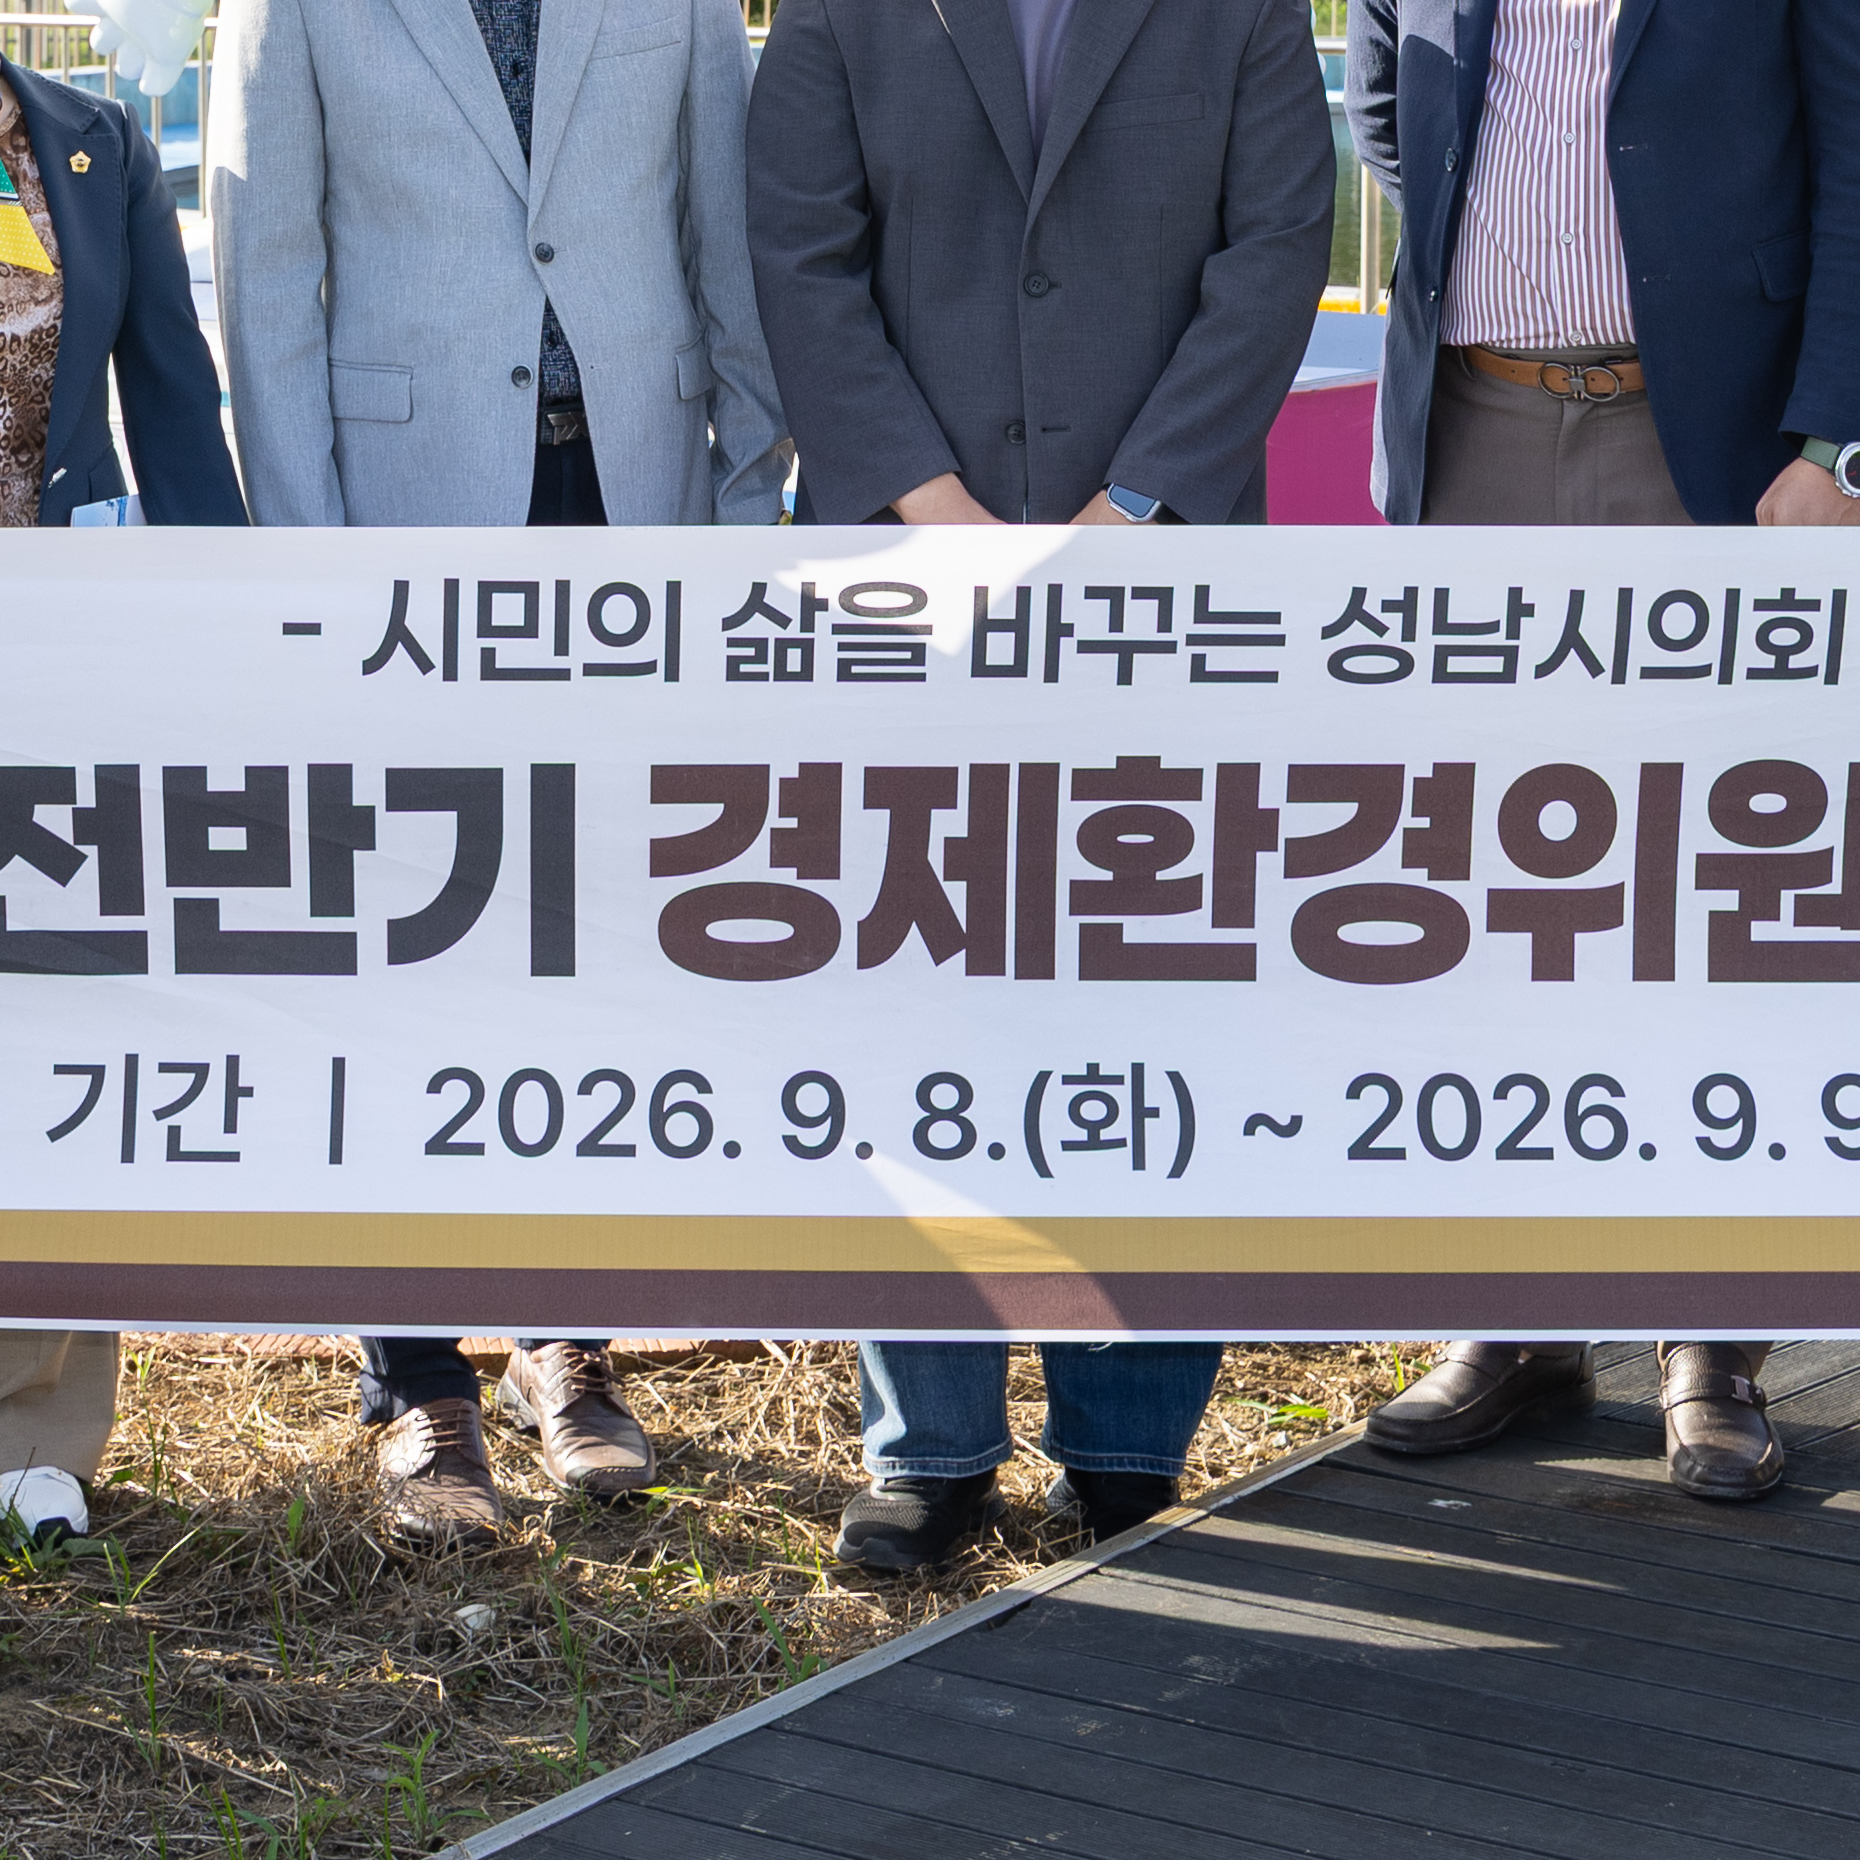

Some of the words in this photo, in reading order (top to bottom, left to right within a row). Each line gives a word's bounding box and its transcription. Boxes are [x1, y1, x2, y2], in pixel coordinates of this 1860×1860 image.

[362, 578, 682, 683] 시민의
[721, 581, 933, 683] 삶을
[970, 583, 1287, 686] 바꾸는
[1320, 586, 1848, 686] 성남시의회
[46, 1053, 254, 1164] 기간
[424, 1066, 742, 1159] 2026.
[1345, 1073, 1657, 1162] 2026.
